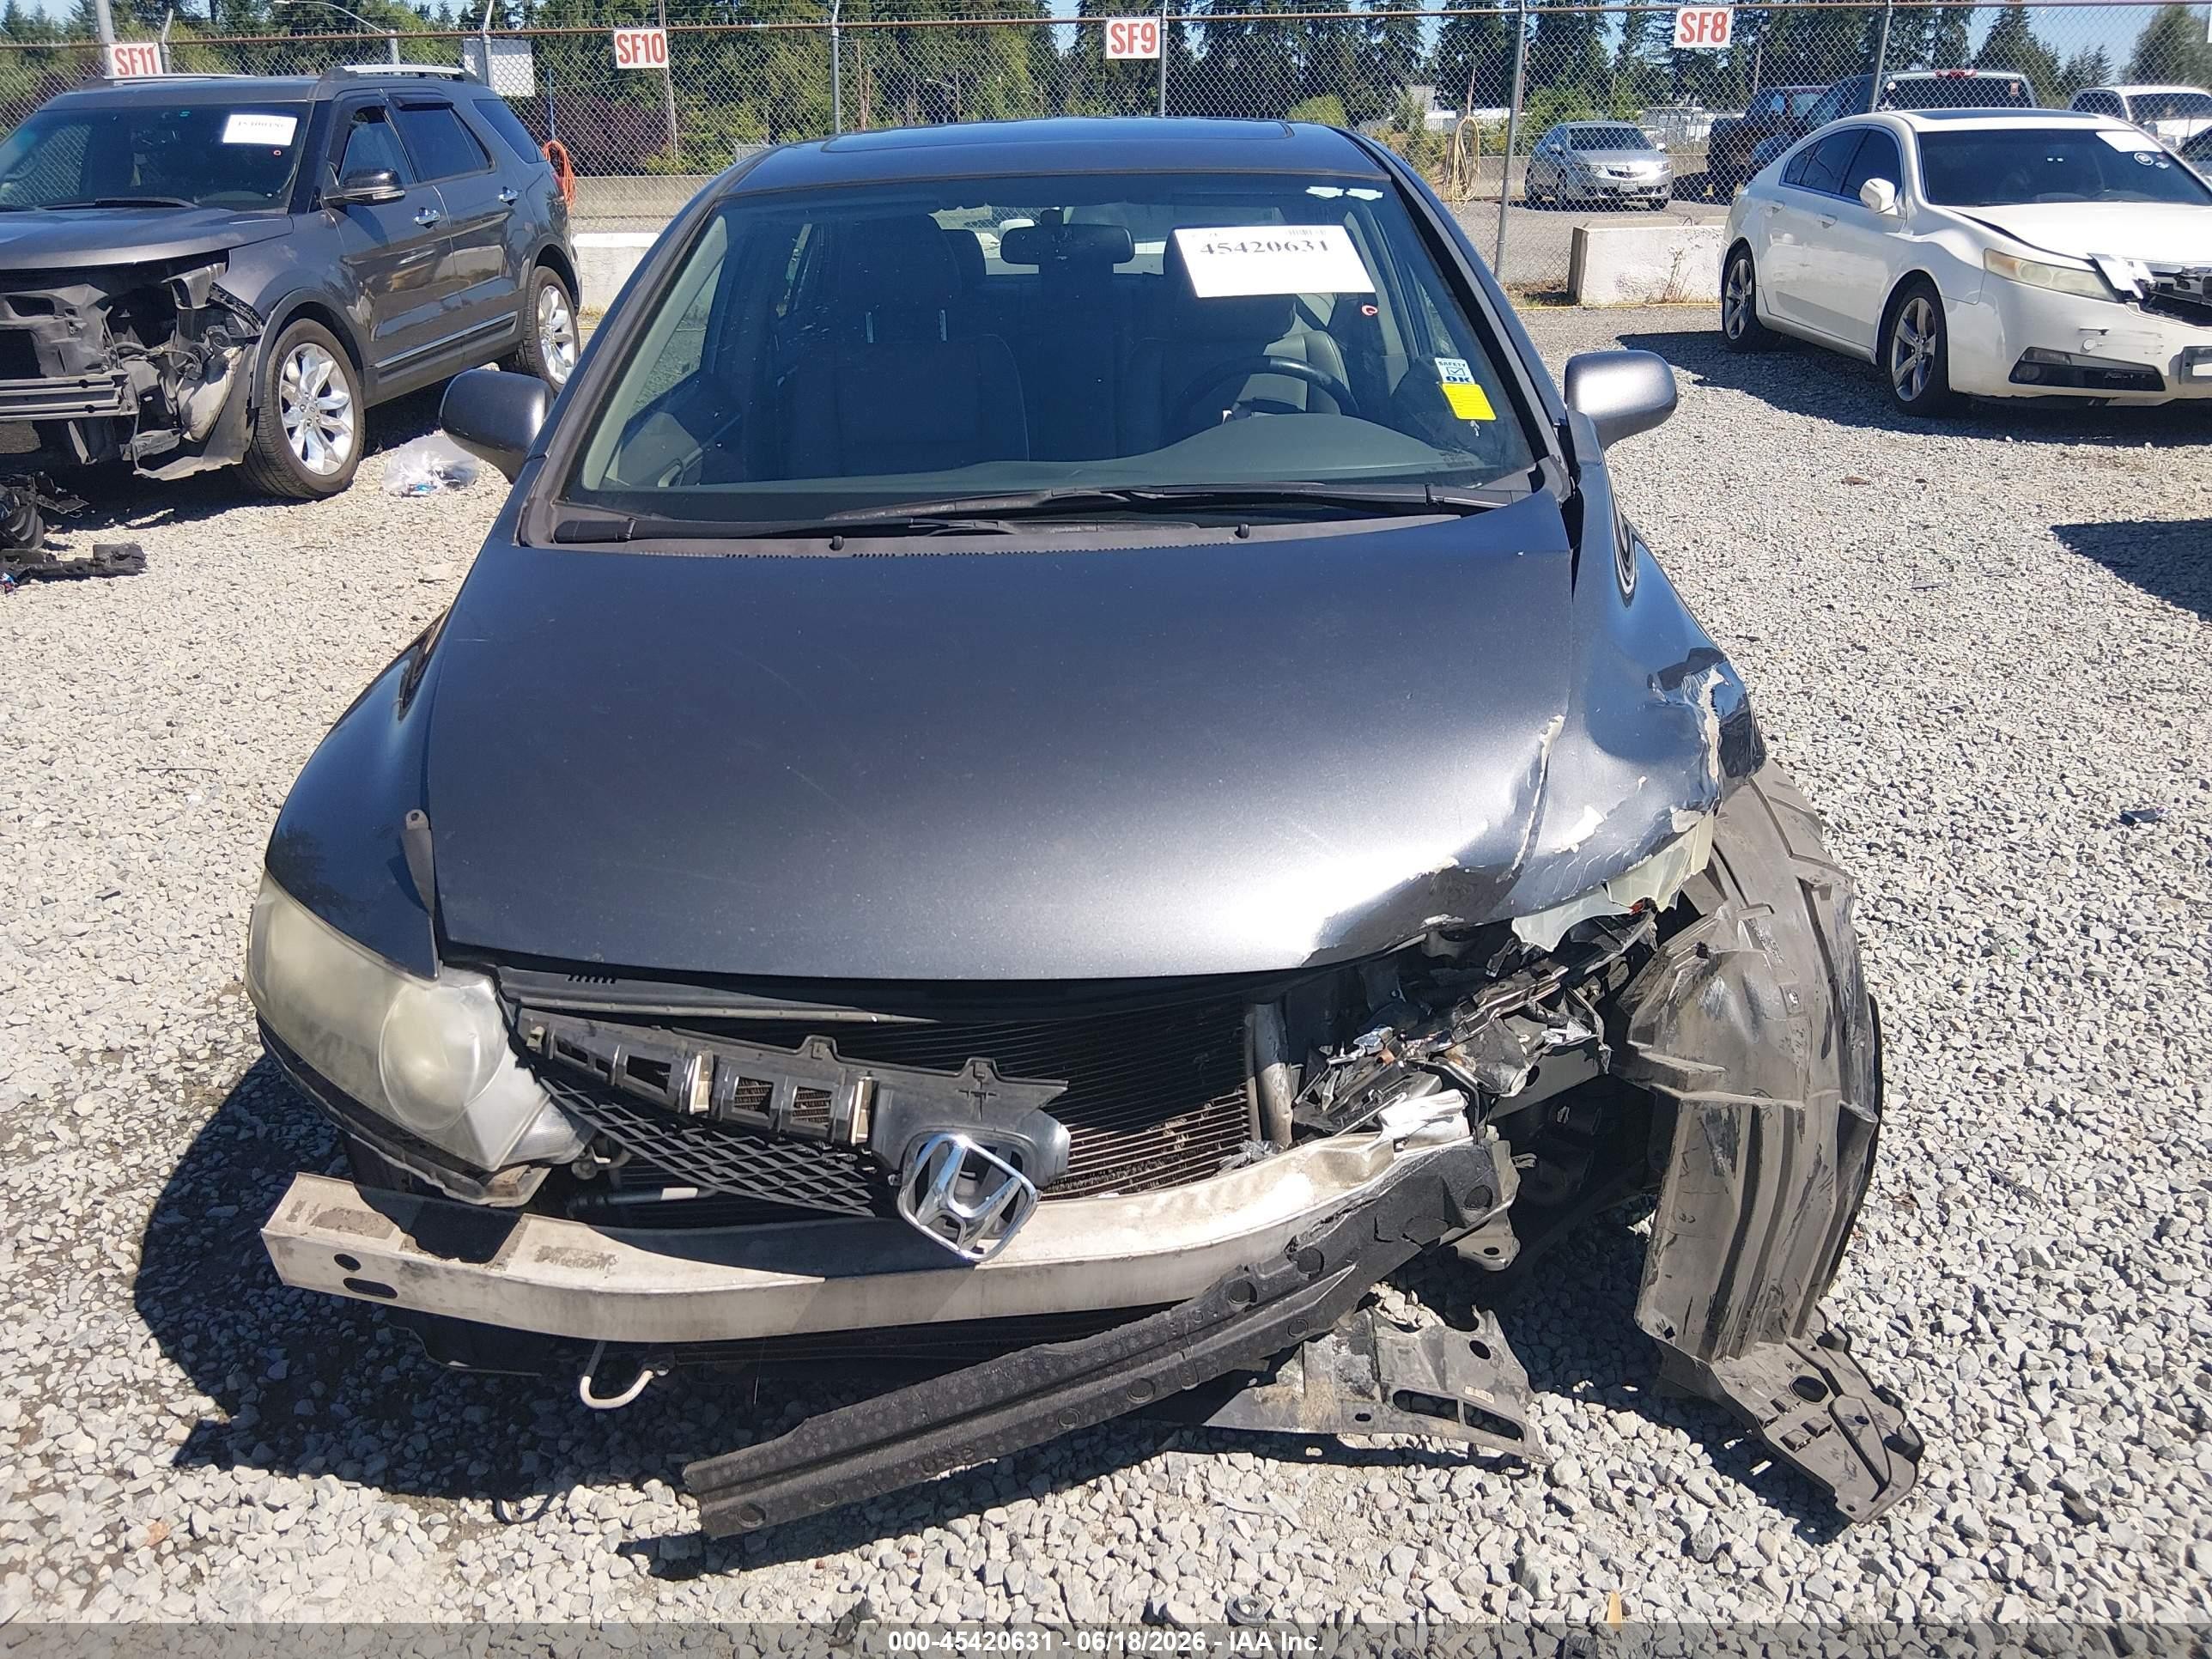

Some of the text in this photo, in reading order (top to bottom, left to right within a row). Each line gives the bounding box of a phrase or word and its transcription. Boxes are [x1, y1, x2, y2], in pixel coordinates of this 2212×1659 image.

[1110, 22, 1157, 54] SF9
[1680, 11, 1728, 43] SF8
[114, 47, 158, 76] SF11
[617, 33, 666, 64] SF10
[1200, 240, 1329, 255] 45420631
